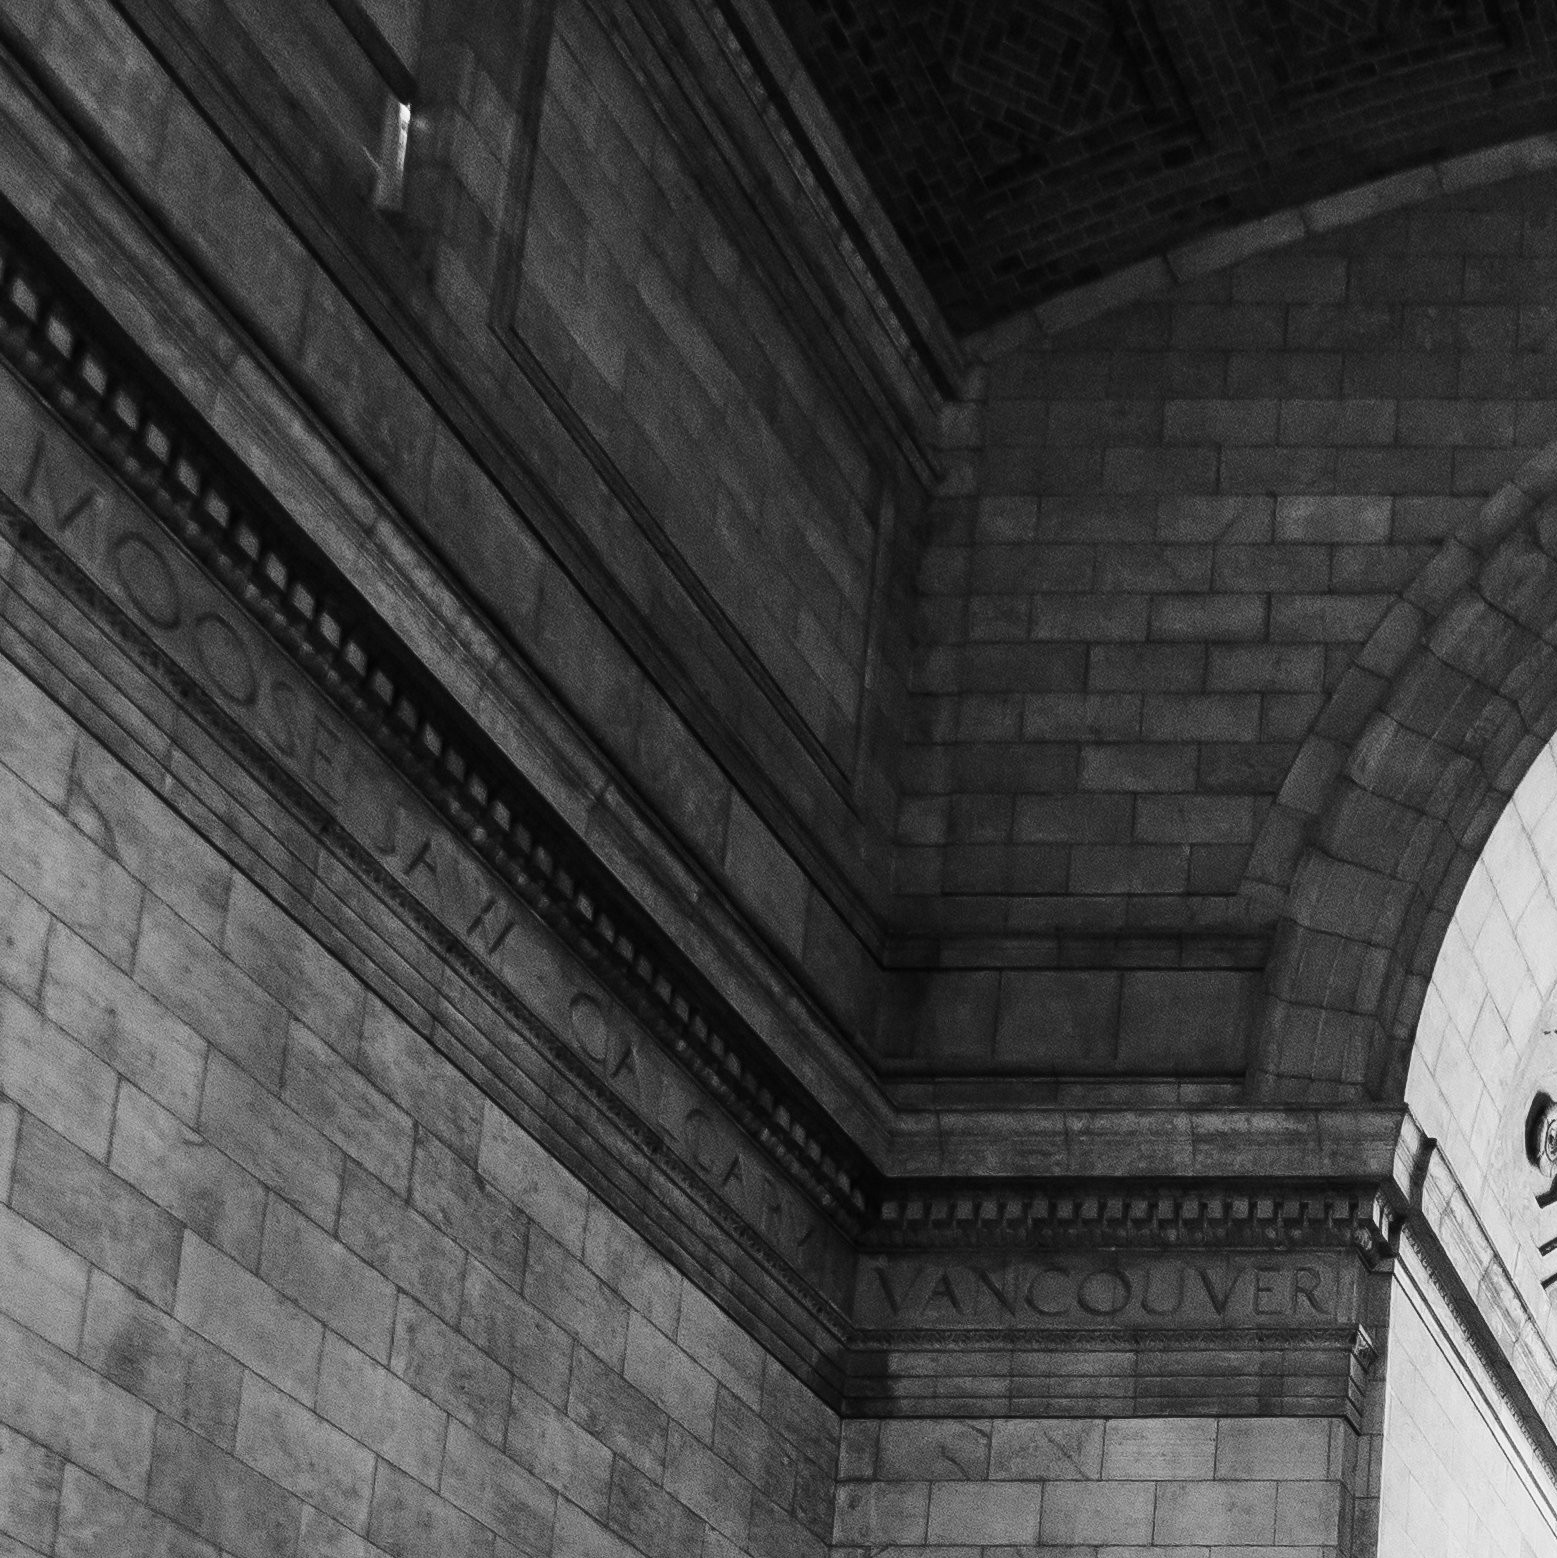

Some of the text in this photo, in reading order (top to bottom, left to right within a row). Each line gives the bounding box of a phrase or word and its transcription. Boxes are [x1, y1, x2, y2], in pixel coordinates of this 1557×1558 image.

[20, 430, 346, 807] MOOSE
[568, 991, 817, 1263] CALGARY
[870, 1265, 1329, 1317] VANCOUVER
